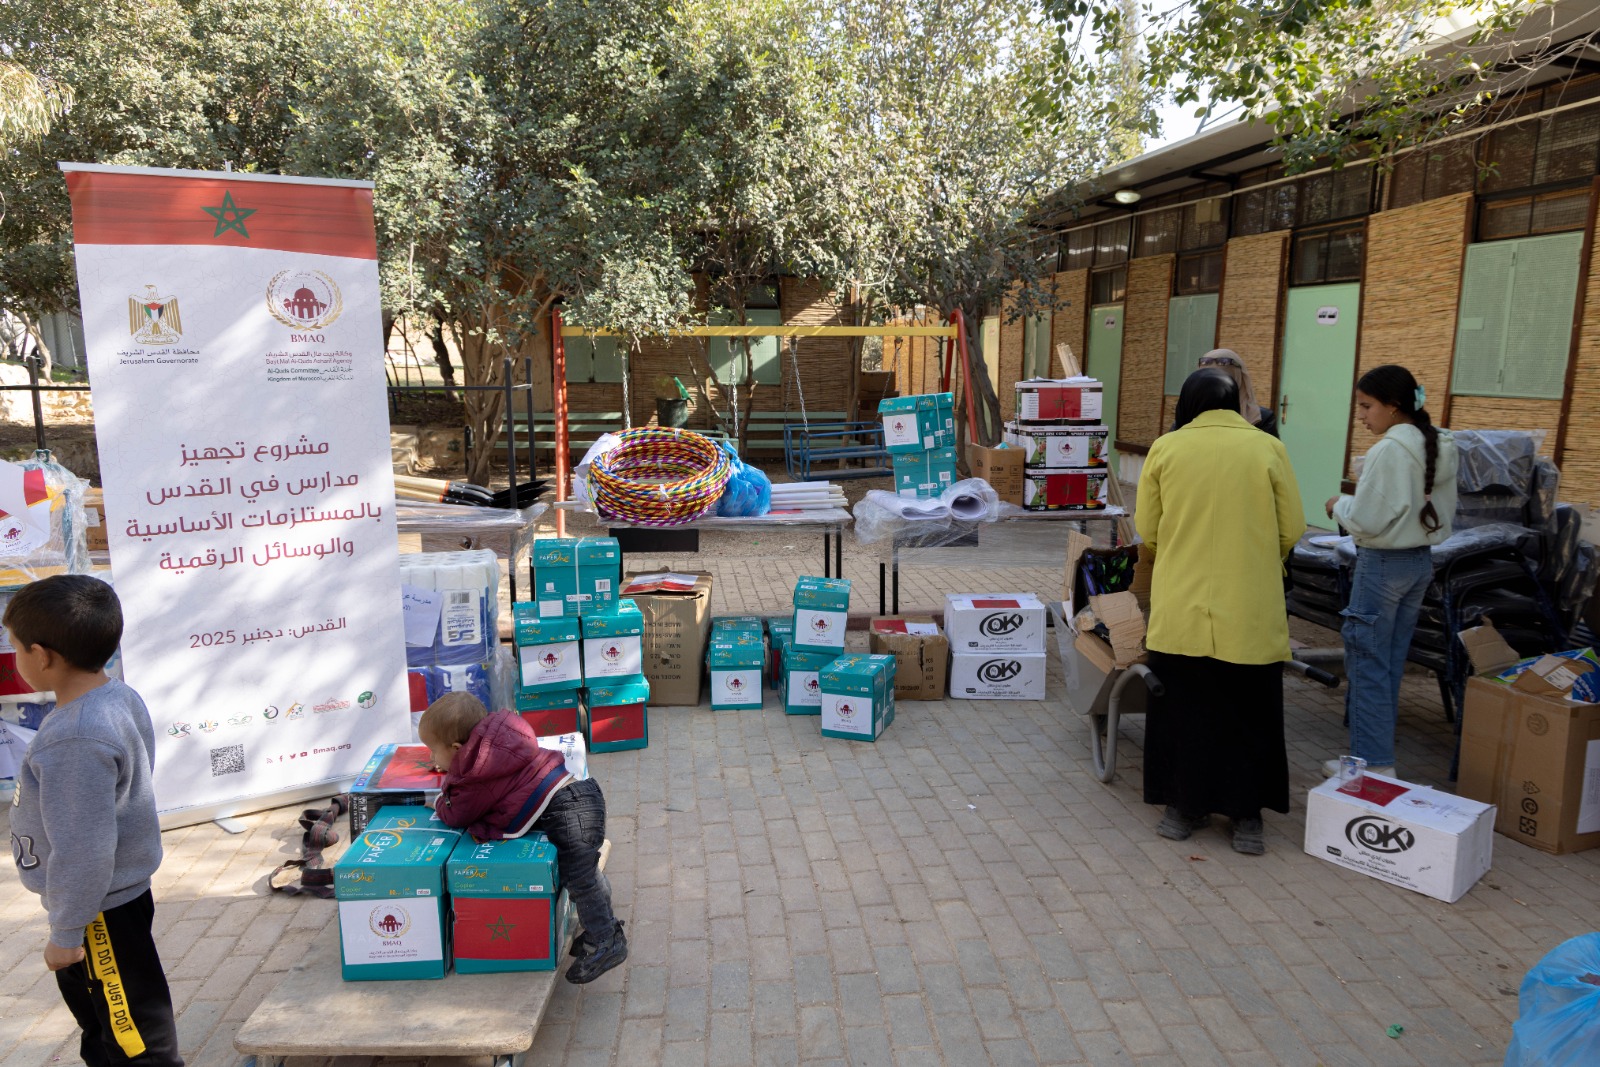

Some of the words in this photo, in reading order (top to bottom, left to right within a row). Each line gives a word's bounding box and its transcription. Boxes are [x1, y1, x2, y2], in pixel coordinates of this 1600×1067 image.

[291, 334, 325, 343] BMAQ
[180, 441, 246, 467] تجهيز
[253, 434, 329, 462] مشروع
[146, 477, 231, 505] القدس
[240, 474, 279, 504] في
[286, 471, 358, 496] مدارس
[126, 510, 233, 542] الأساسية
[241, 502, 382, 529] بالمستلزمات
[159, 546, 244, 574] الرقمية
[252, 537, 354, 566] والوسائل
[190, 630, 236, 648] 2025
[242, 627, 284, 645] دجنبر
[288, 617, 346, 639] القدس:
[313, 743, 352, 755] Bmaq.org
[363, 835, 394, 863] PAPER
[476, 843, 494, 859] PAP
[93, 921, 108, 946] JUST
[97, 949, 112, 966] DO
[102, 966, 116, 976] IT
[107, 981, 123, 1006] JUST
[114, 1009, 128, 1026] DO
[118, 1024, 133, 1034] IT
